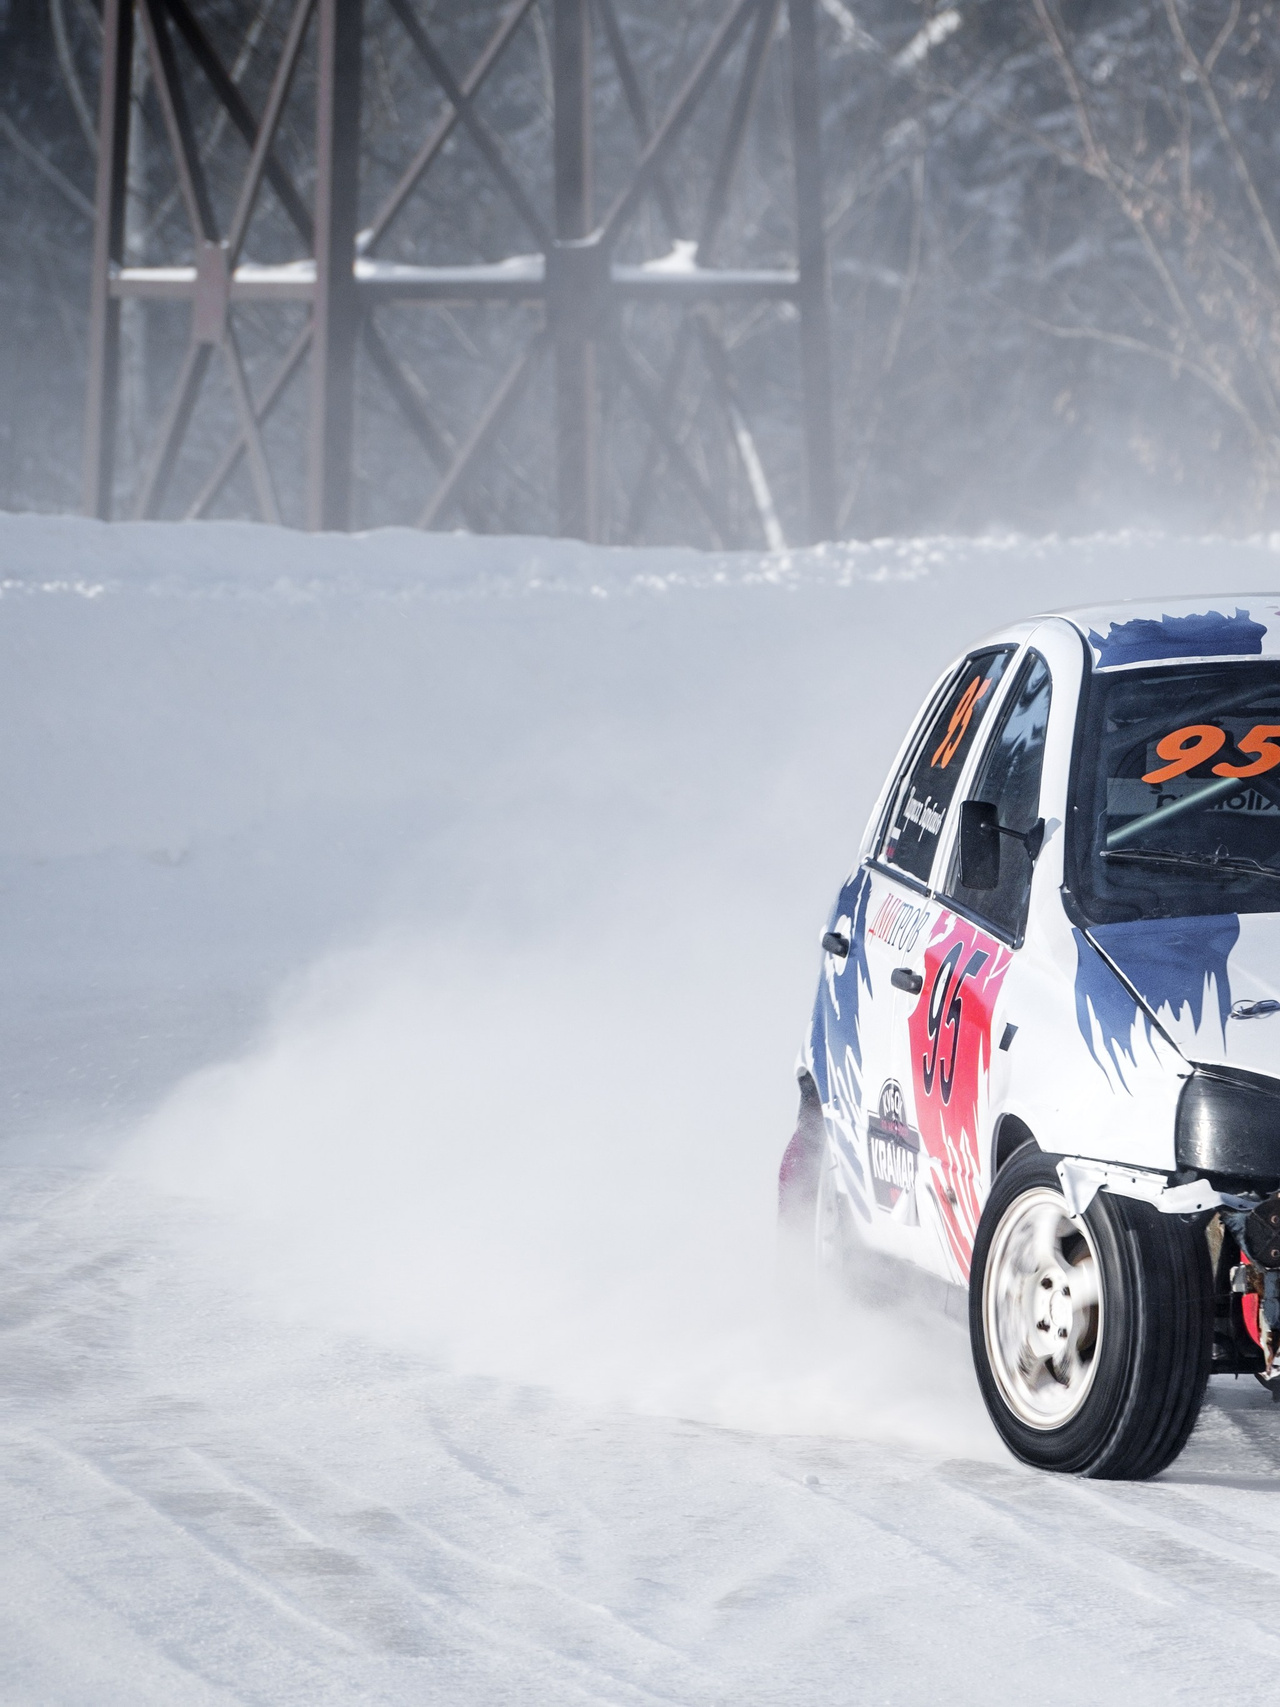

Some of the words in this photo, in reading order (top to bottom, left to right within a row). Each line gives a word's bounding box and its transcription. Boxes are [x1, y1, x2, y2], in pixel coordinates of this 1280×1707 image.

[930, 675, 993, 769] 95
[868, 893, 931, 953] ДМИТРОВ
[922, 940, 991, 1107] 95
